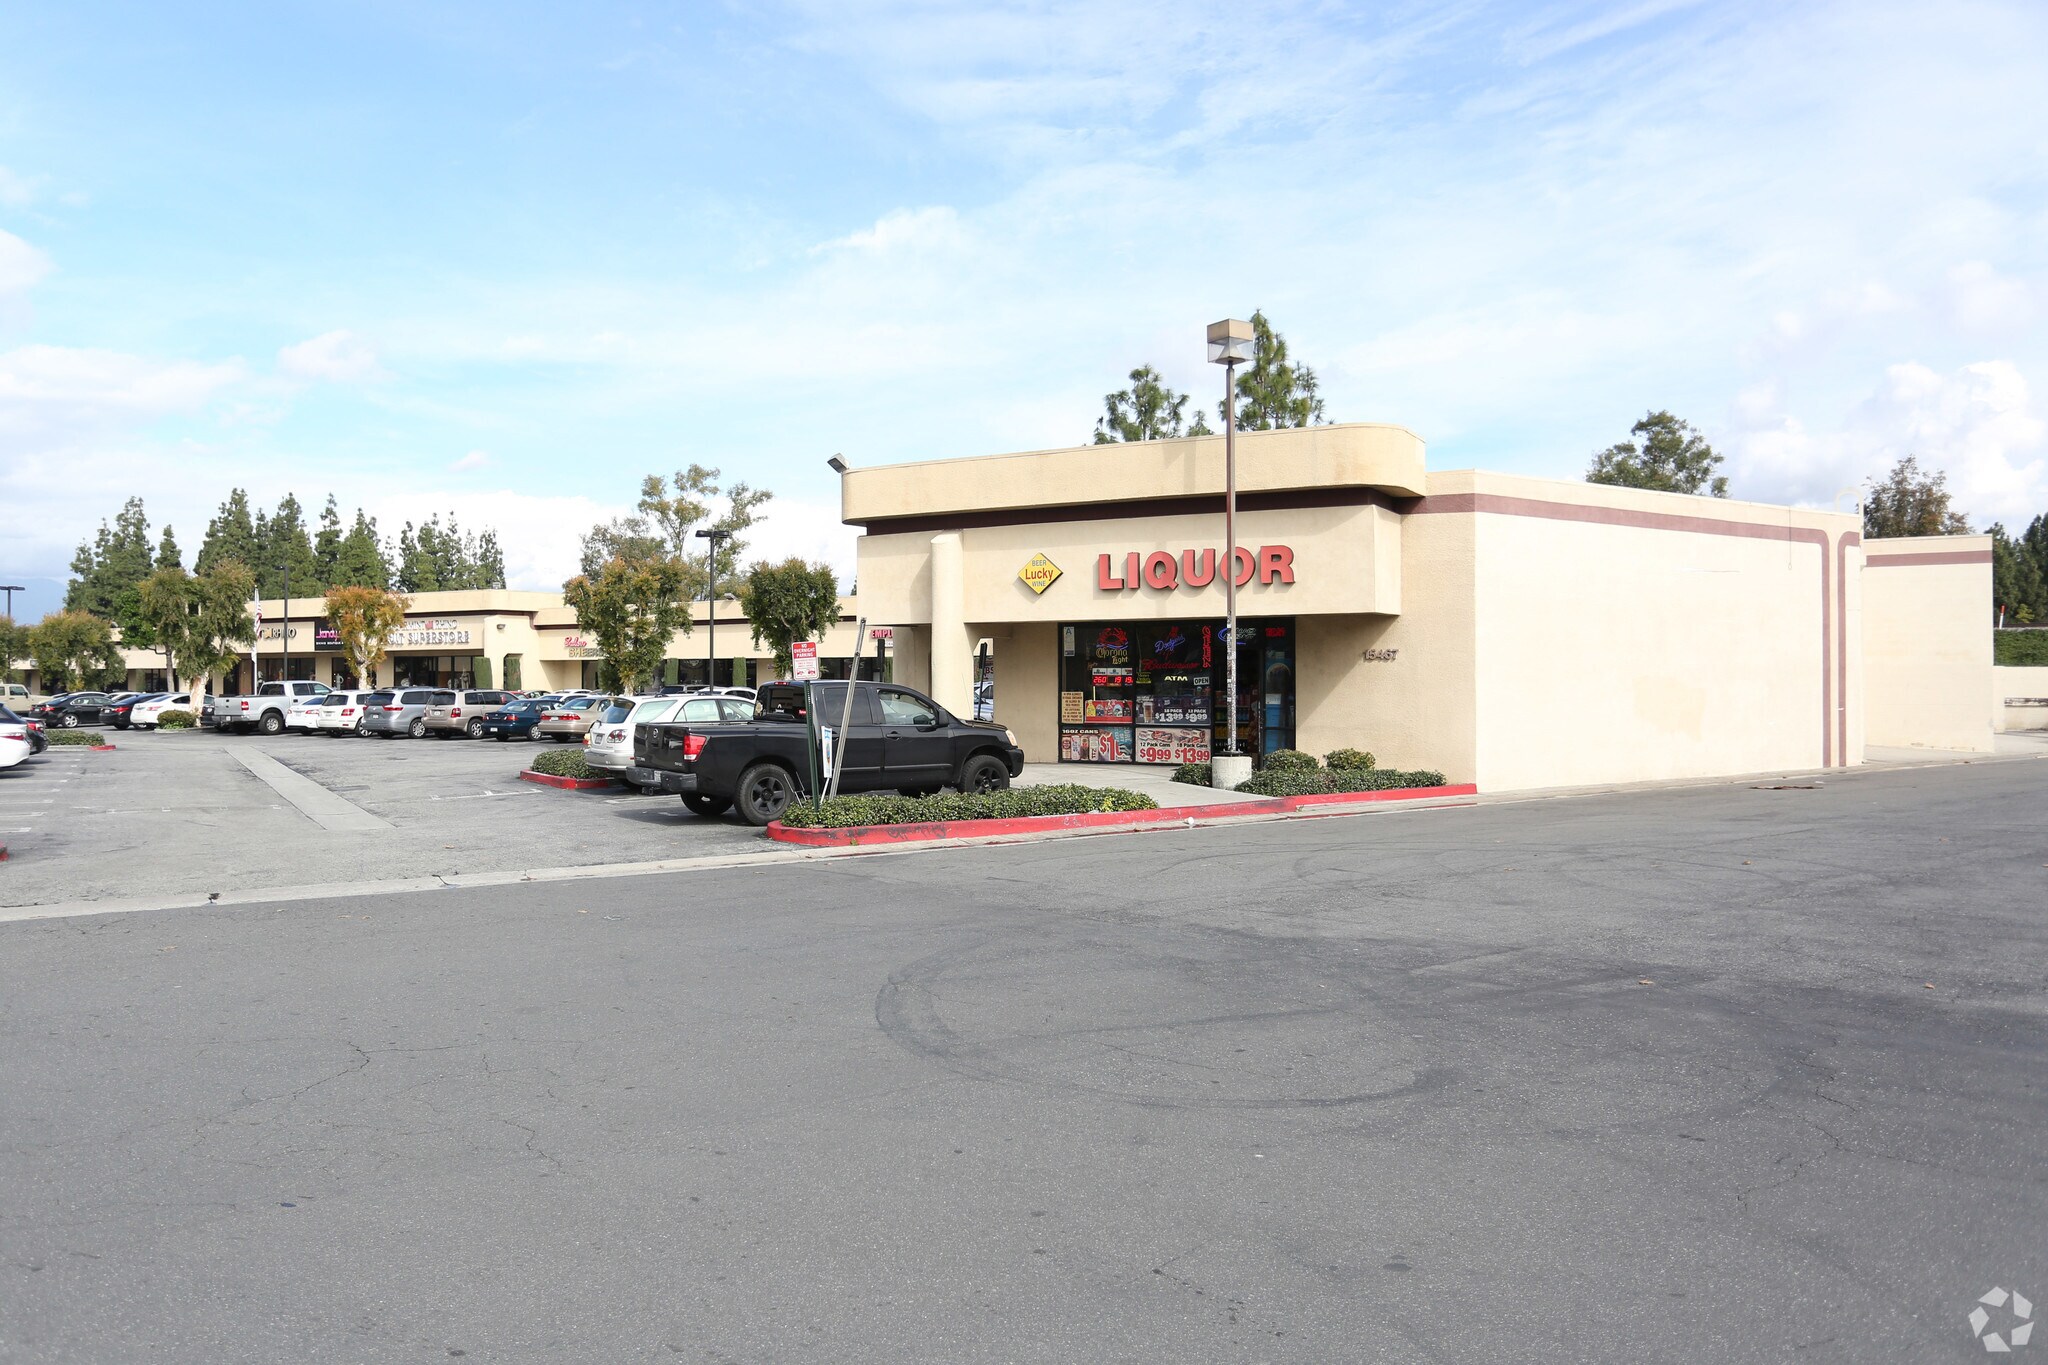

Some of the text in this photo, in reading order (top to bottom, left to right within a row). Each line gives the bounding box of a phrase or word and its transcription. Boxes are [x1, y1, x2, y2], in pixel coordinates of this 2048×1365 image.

[1031, 559, 1047, 567] BEER
[1098, 545, 1295, 590] LIQUOR
[1025, 568, 1054, 581] Lucky
[408, 630, 470, 645] SUPERSTORE
[1096, 647, 1128, 658] Corona
[1363, 649, 1398, 661] 15467
[1194, 677, 1209, 685] OPEN
